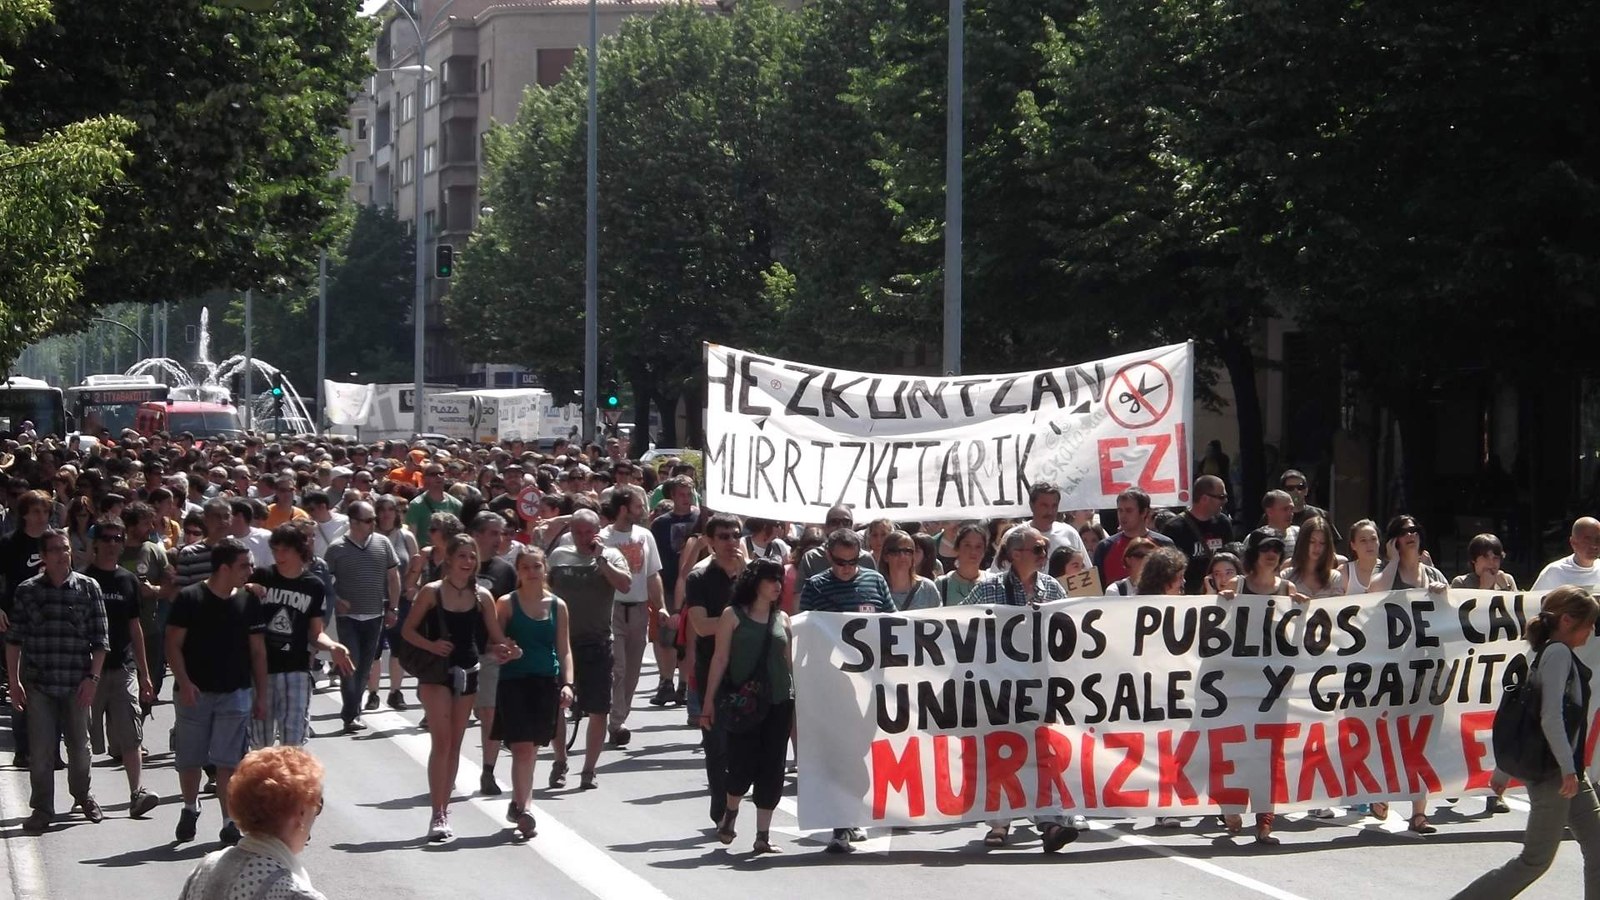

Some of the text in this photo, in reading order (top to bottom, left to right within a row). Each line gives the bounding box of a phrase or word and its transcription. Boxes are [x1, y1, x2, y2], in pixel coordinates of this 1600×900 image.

[705, 352, 1105, 420] HEZKUNTZAN
[705, 433, 1033, 510] MURRIZKETARIK
[1097, 422, 1190, 501] EZ!
[1066, 570, 1093, 593] EZ
[840, 594, 1528, 673] SERVICIOS PUBLICOS DE CAL
[875, 648, 1529, 733] UNIVERSALES Y GRATUITO
[871, 710, 1444, 820] MURRIZKETARIK
